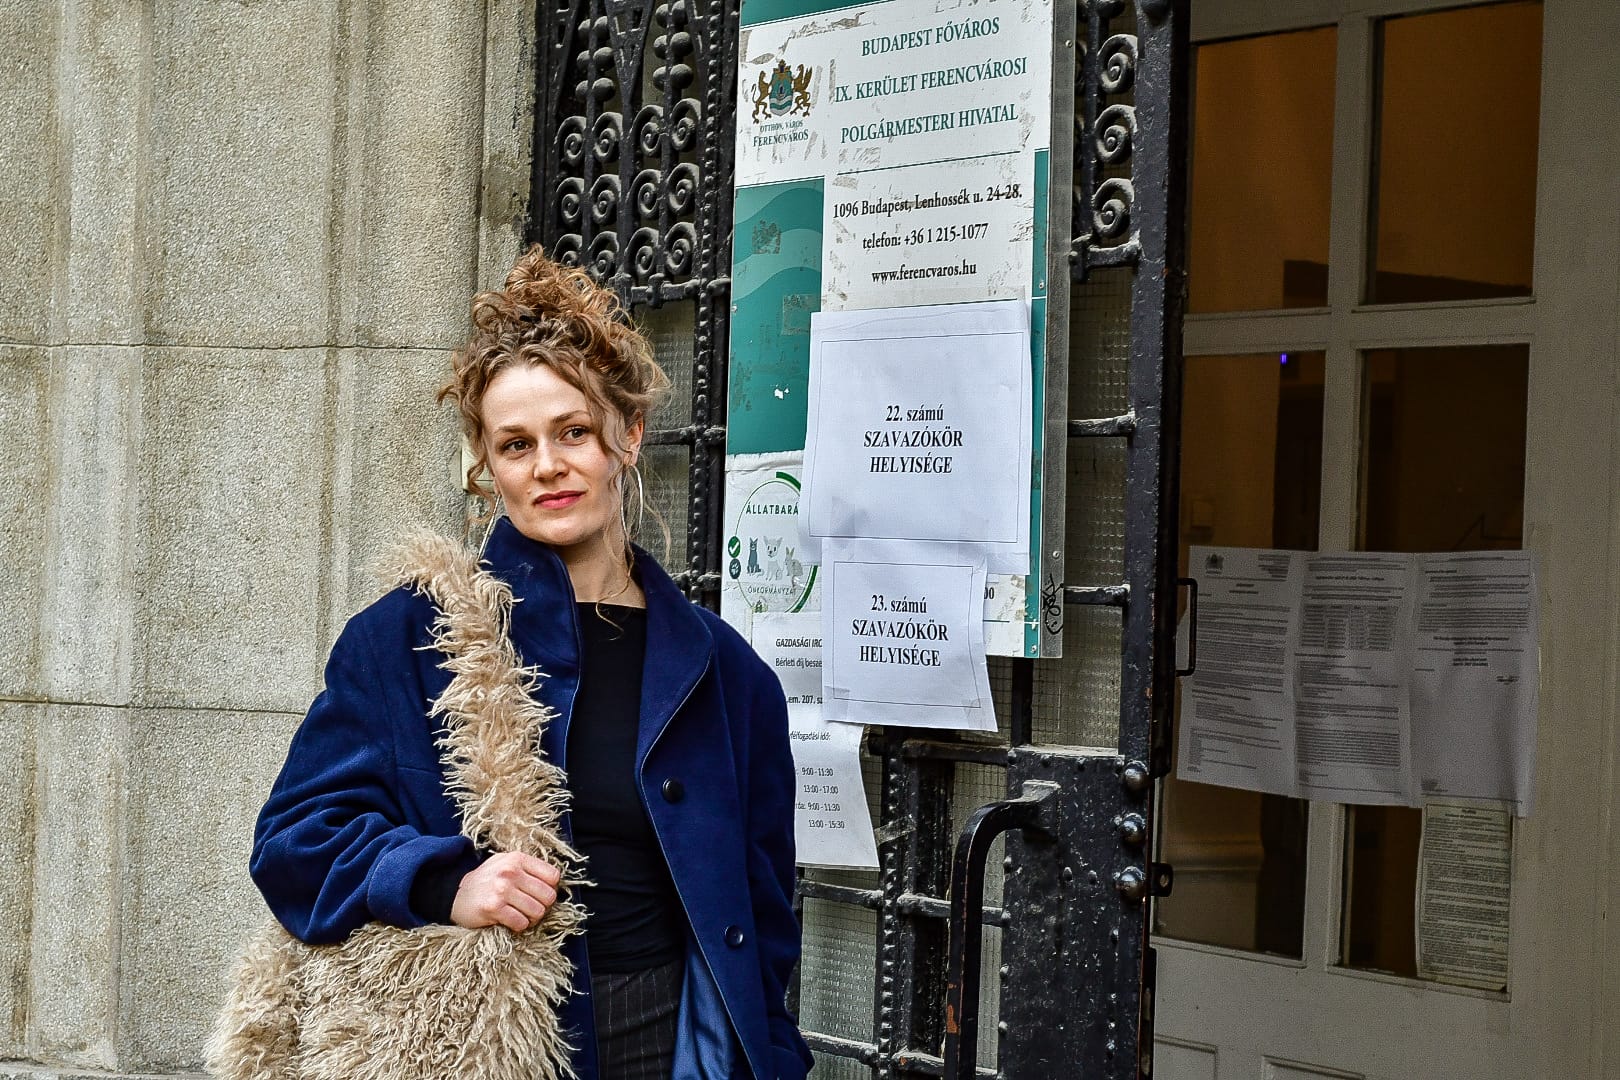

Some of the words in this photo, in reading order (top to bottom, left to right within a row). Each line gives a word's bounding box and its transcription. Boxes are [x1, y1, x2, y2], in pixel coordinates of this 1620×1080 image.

[861, 28, 933, 56] BUDAPEST
[936, 17, 1000, 45] FŐVÁROS
[835, 85, 853, 103] IX.
[856, 75, 918, 100] KERÜLET
[921, 57, 1027, 90] FERENCVÁROSI
[841, 112, 955, 144] POLGÁRMESTERI
[958, 103, 1019, 128] HIVATAL
[833, 201, 859, 219] 1096
[861, 197, 912, 218] Budapest,
[915, 188, 970, 210] Lenhossék
[973, 190, 984, 203] u.
[986, 183, 1023, 202] 24-28.
[862, 231, 902, 250] telefon:
[904, 228, 924, 246] +36
[927, 228, 933, 244] 1
[935, 222, 989, 243] 215-1077
[872, 258, 977, 284] www.ferencvaros.hu
[886, 405, 903, 422] 22.
[906, 404, 944, 422] számú
[863, 426, 963, 448] SZAVAZÓKÖR
[869, 451, 953, 474] HELYISÉGE
[871, 594, 888, 612] 23.
[890, 592, 928, 614] számú
[852, 618, 949, 642] SZAVAZÓKÖR
[775, 637, 811, 648] GAZDASÁGI
[859, 644, 941, 668] HELYISÉGE
[801, 694, 816, 705] 207.
